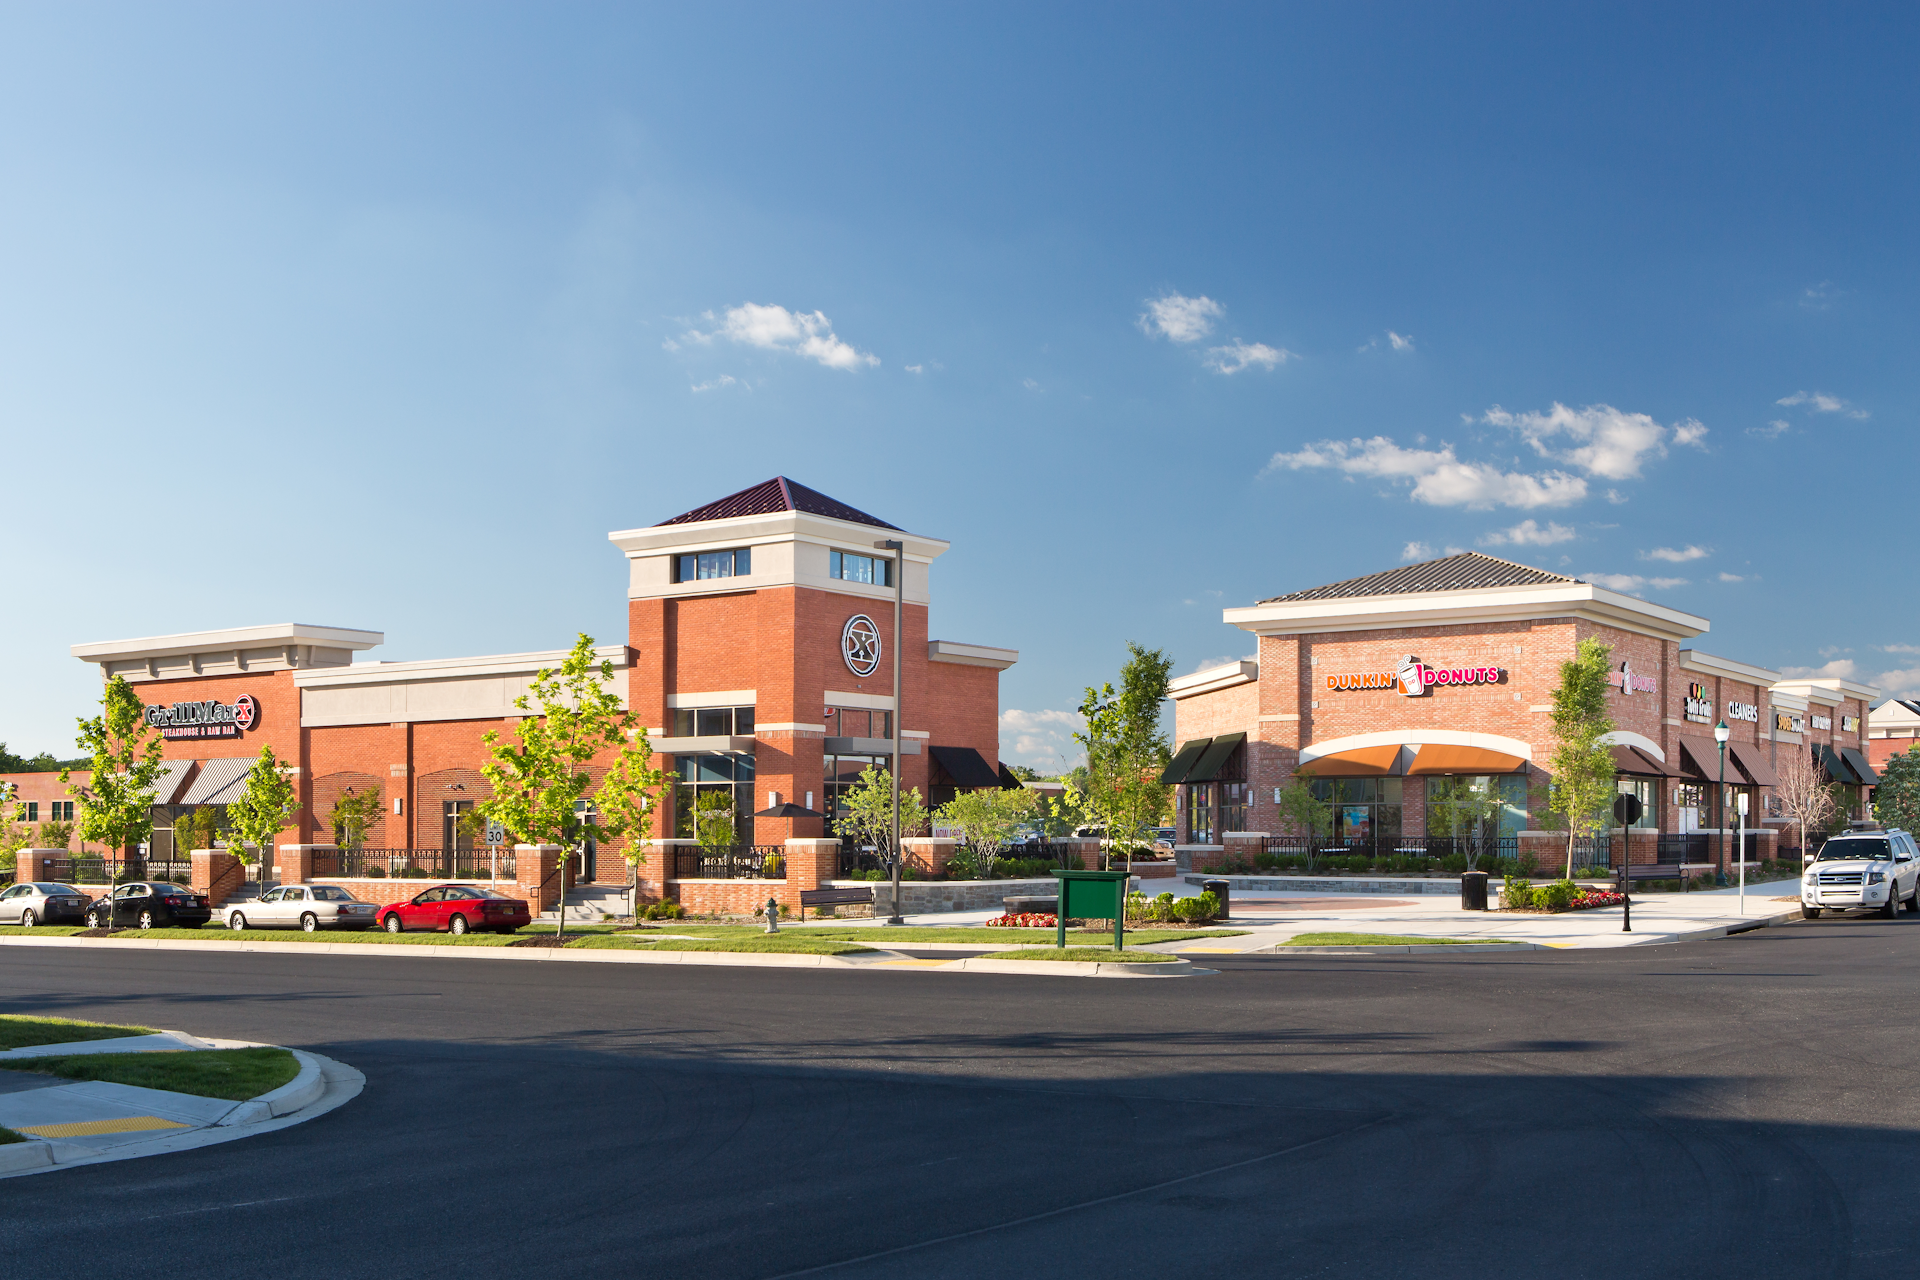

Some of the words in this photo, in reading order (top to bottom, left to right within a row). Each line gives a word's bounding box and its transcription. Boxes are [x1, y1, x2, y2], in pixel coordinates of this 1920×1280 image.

[1326, 673, 1397, 689] DUNKIN'
[1424, 667, 1498, 685] DONUTS
[1632, 674, 1656, 693] DONUTS
[1728, 701, 1758, 723] CLEANERS
[161, 727, 199, 737] STEAKHOUSE
[207, 726, 220, 736] RAW
[222, 725, 235, 735] BAR
[488, 831, 502, 842] 30
